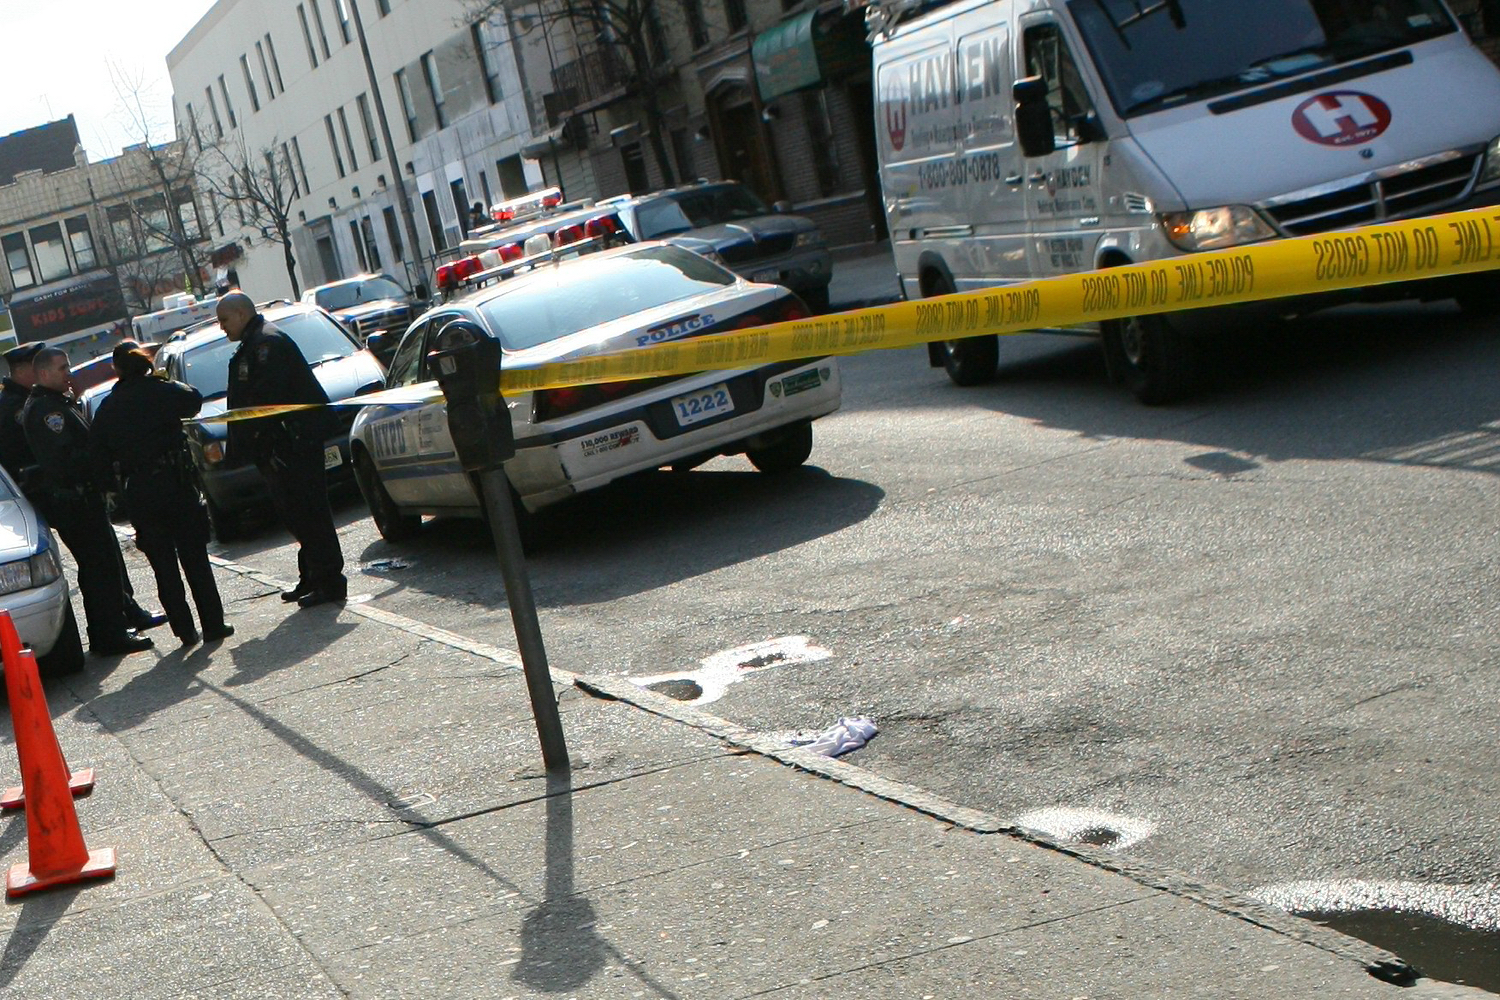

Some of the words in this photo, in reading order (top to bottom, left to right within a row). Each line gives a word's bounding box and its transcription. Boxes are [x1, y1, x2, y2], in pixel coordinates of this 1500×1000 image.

[1302, 95, 1379, 137] H
[635, 312, 716, 348] POLICE
[677, 390, 729, 418] 1222
[580, 435, 609, 450] $10,000
[609, 426, 639, 440] REWARD
